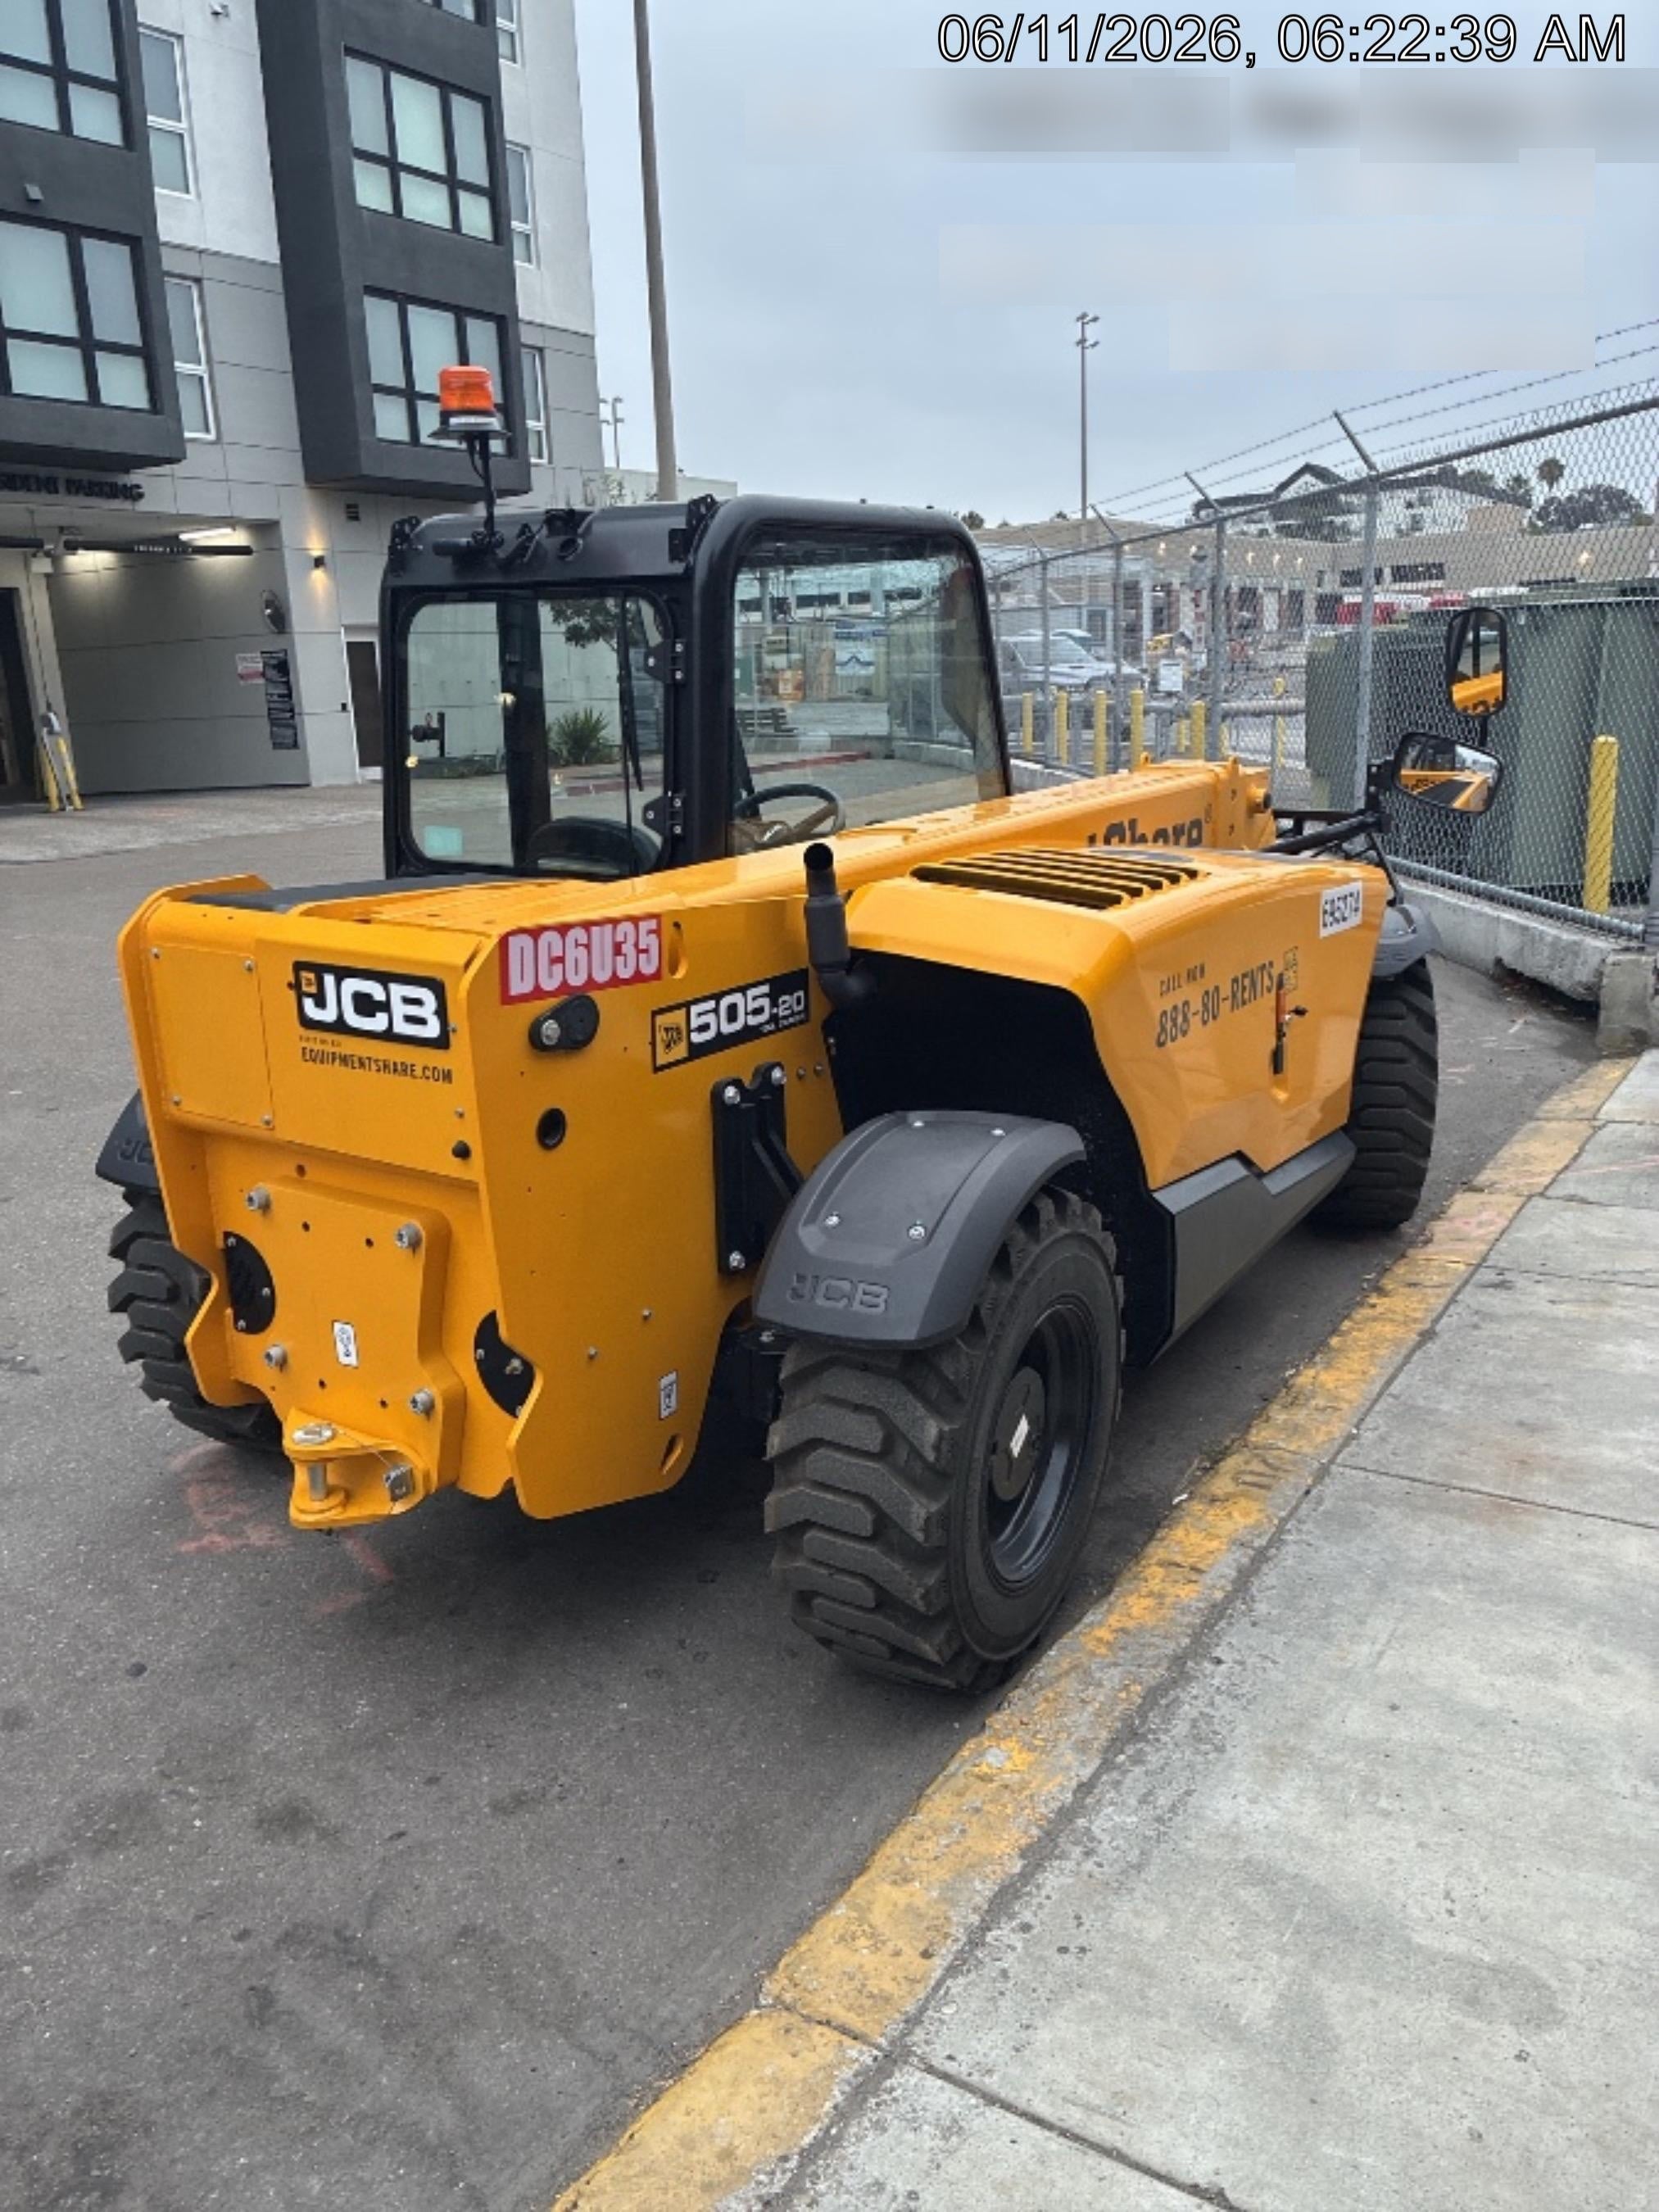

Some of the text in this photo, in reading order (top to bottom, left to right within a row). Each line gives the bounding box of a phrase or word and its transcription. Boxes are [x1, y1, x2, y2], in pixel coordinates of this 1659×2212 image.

[507, 918, 660, 996] DC6U35
[1159, 972, 1182, 998] CALL
[302, 972, 442, 1039] JCB
[690, 984, 805, 1044] 505-20
[1156, 960, 1275, 1048] 888-80-RENTS
[301, 1045, 453, 1084] EQUIPMENTSHARE.COM
[787, 1272, 891, 1316] JCB
